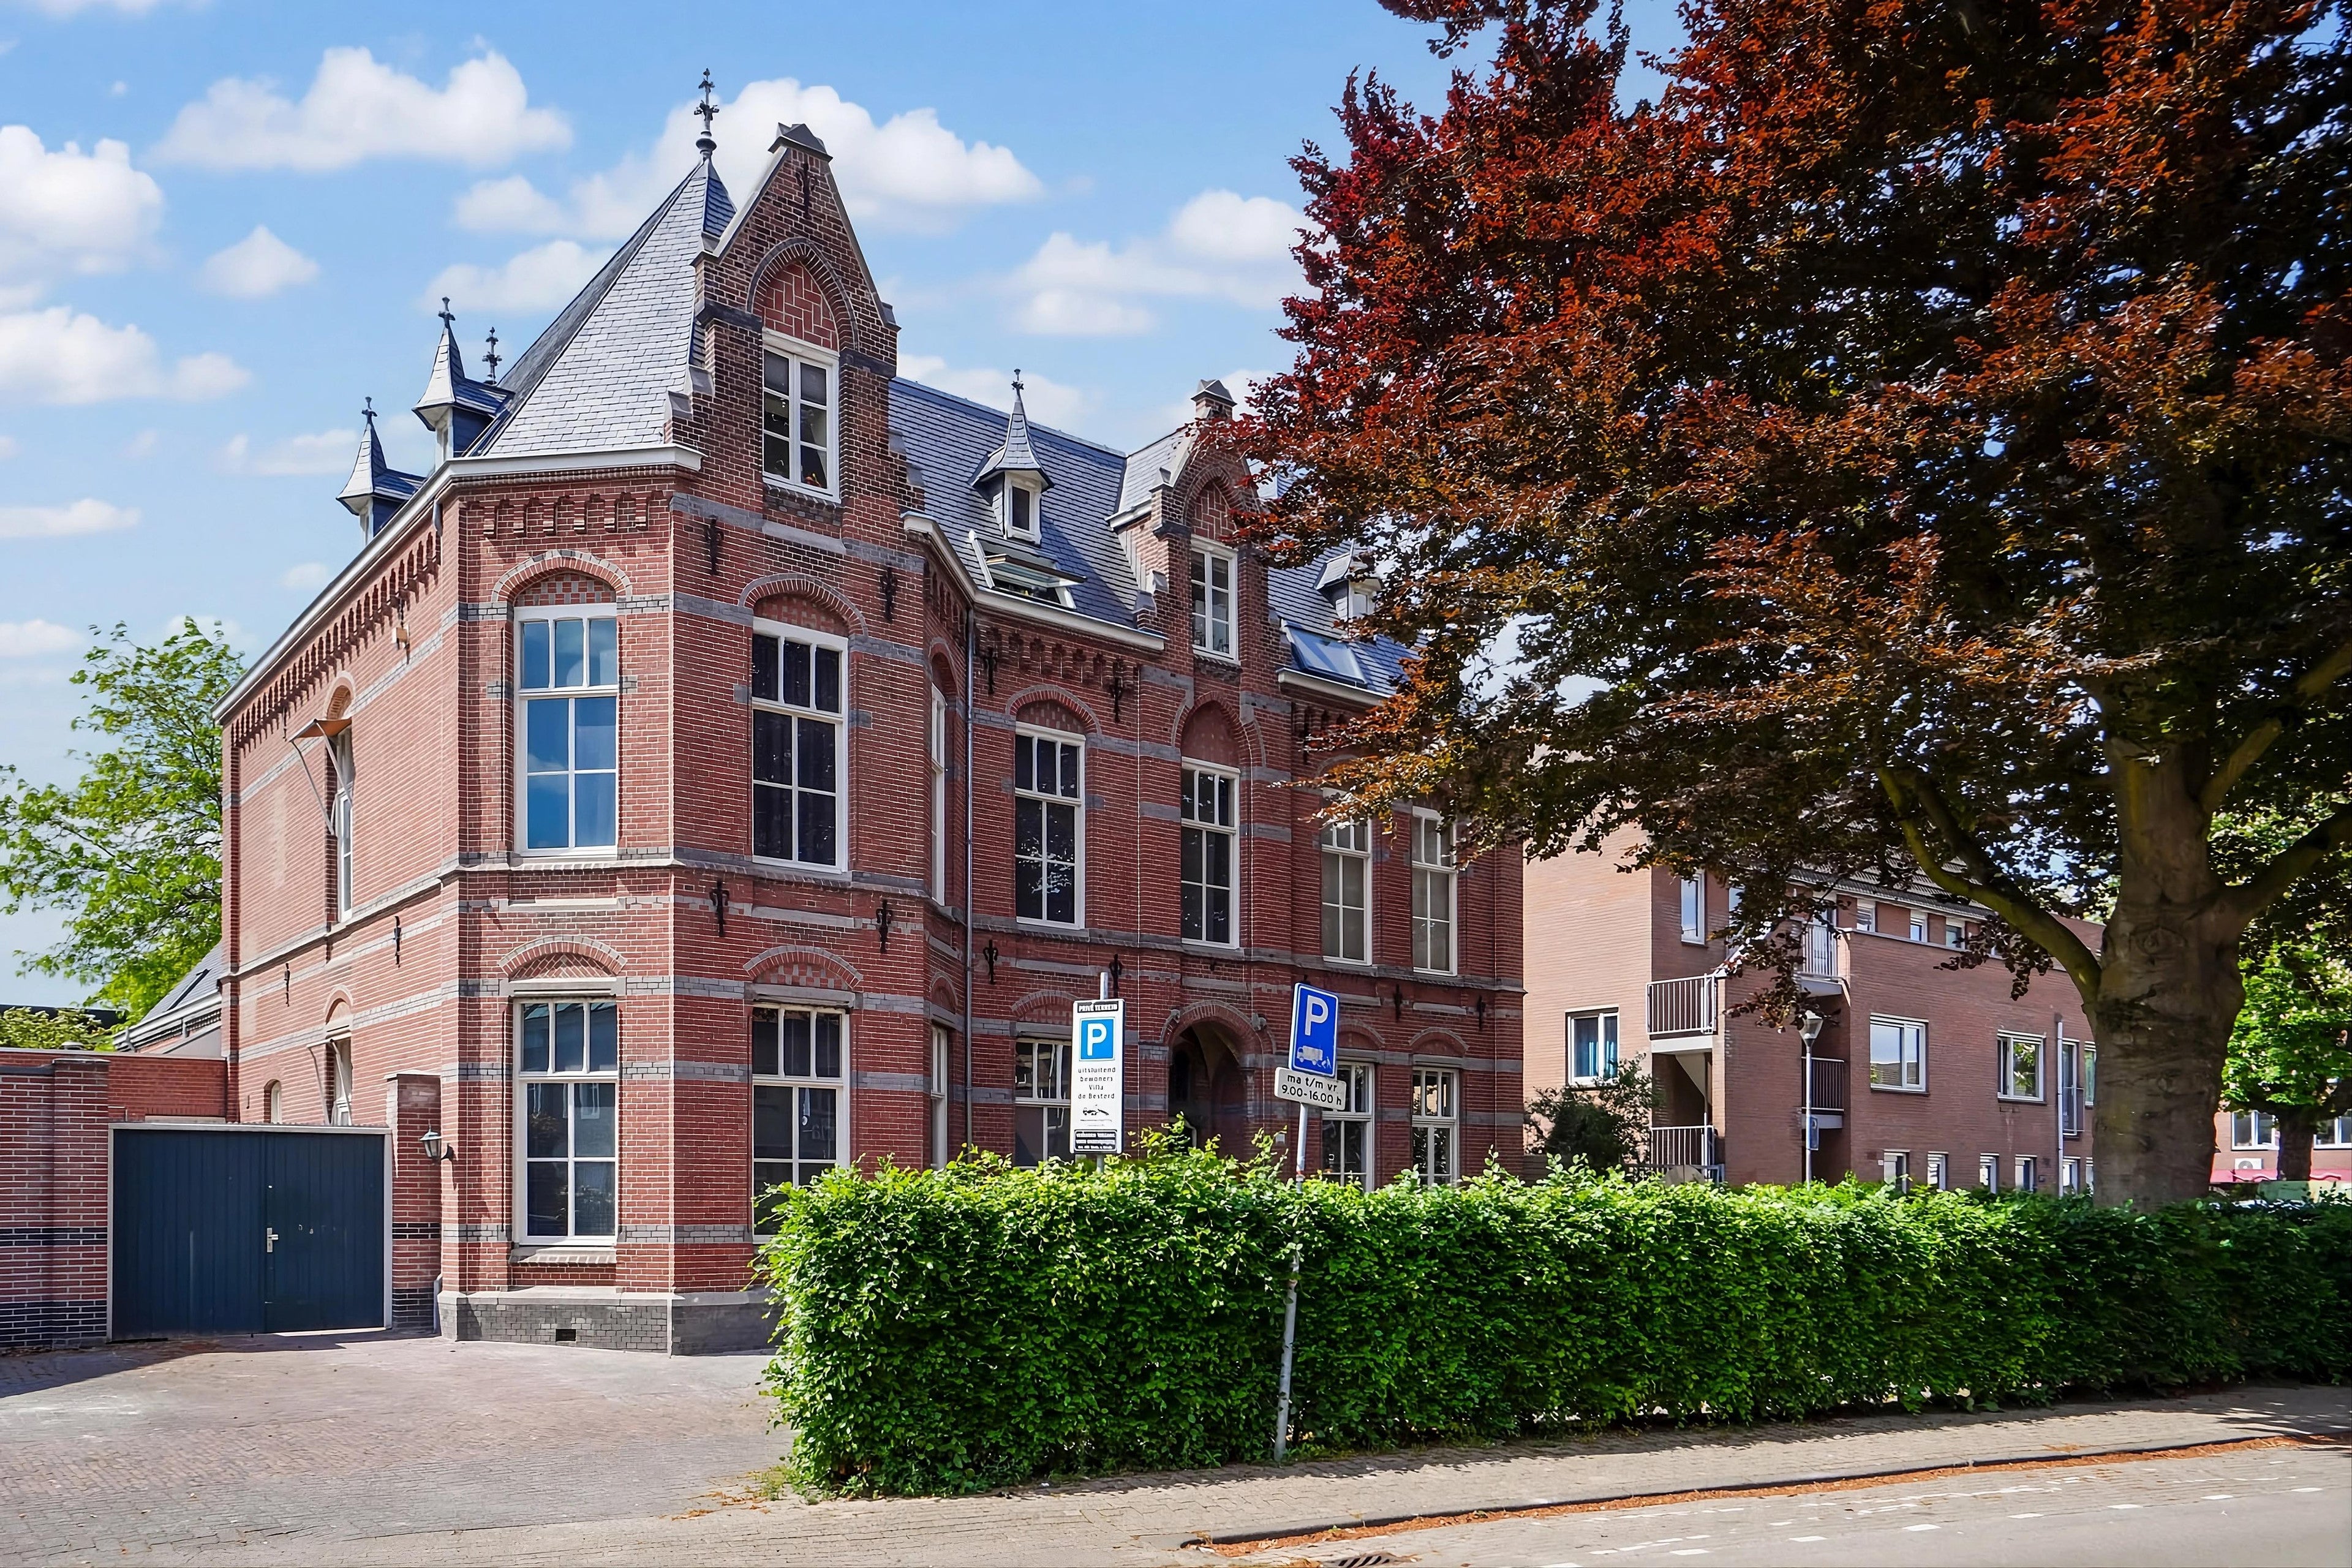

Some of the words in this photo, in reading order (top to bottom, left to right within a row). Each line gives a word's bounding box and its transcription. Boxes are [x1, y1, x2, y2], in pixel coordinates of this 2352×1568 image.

[1305, 995, 1329, 1036] P
[1087, 1023, 1107, 1056] P
[1281, 1084, 1333, 1103] 9.00-16.00
[1336, 1096, 1341, 1105] h
[1287, 1075, 1301, 1084] ma
[1305, 1077, 1323, 1089] t/m
